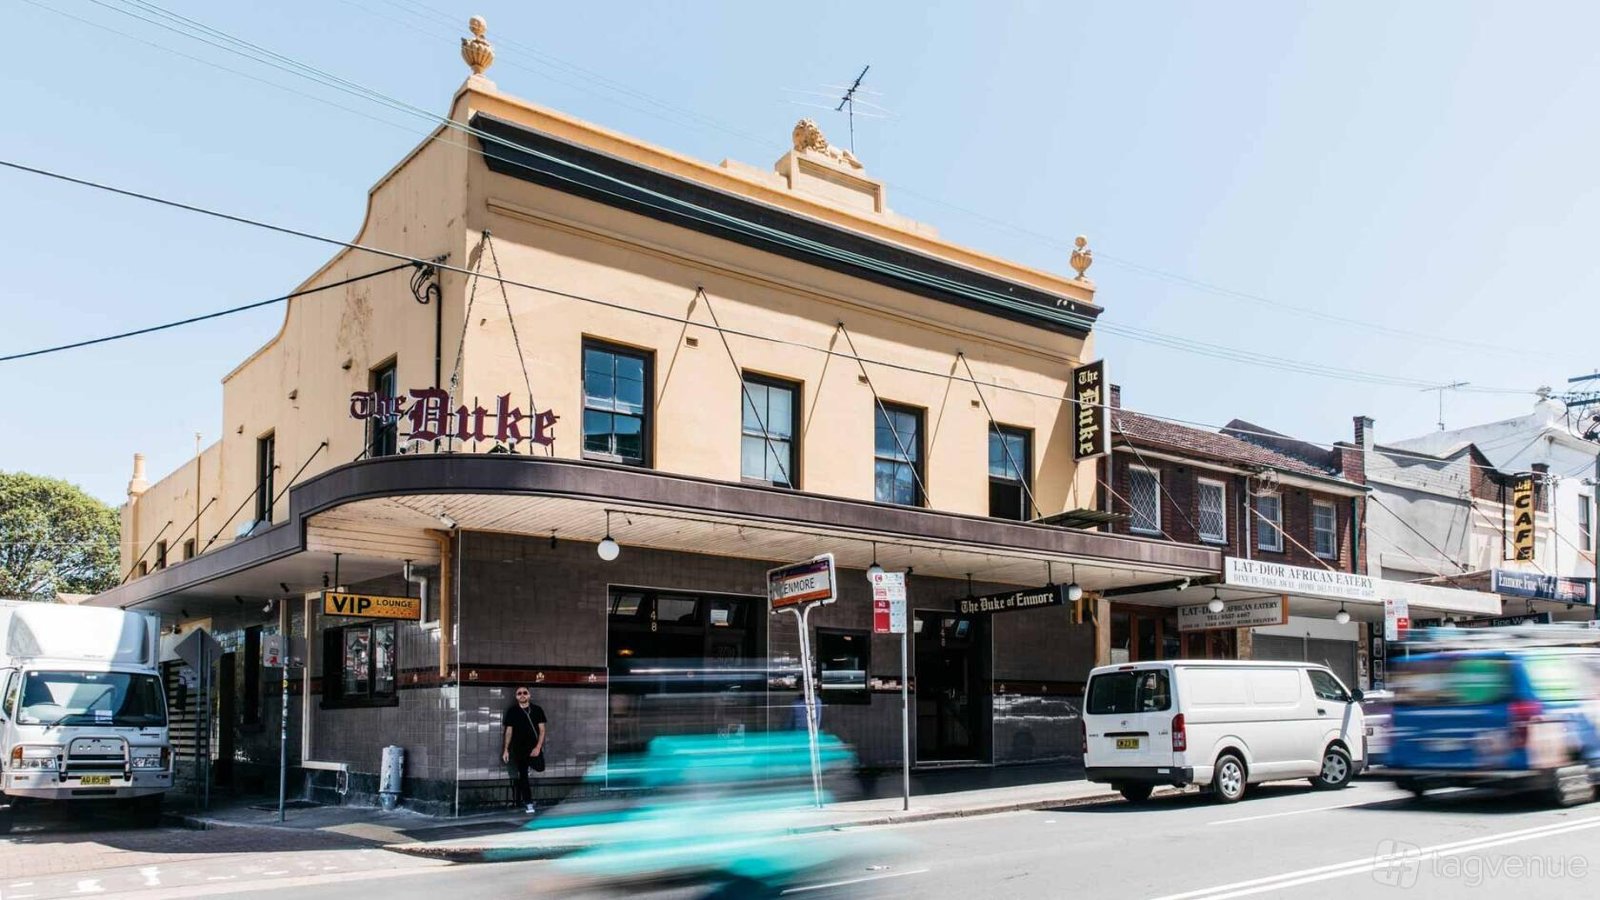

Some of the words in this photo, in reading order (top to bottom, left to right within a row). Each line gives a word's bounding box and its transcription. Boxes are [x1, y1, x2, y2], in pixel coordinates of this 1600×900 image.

[1079, 370, 1098, 384] The
[350, 390, 406, 425] The
[407, 387, 560, 446] Duke
[1079, 385, 1099, 454] Duke
[1515, 495, 1532, 560] CAFE
[1289, 568, 1333, 583] AFRICAN
[1336, 573, 1374, 588] EATERY
[332, 596, 371, 613] VIP
[376, 600, 412, 608] LOUNGE
[961, 601, 979, 614] The
[979, 596, 1005, 611] Duke
[1006, 597, 1015, 606] of
[1016, 592, 1054, 606] Enmore
[1226, 603, 1252, 612] AFRICAN
[1253, 601, 1278, 609] EATERY
